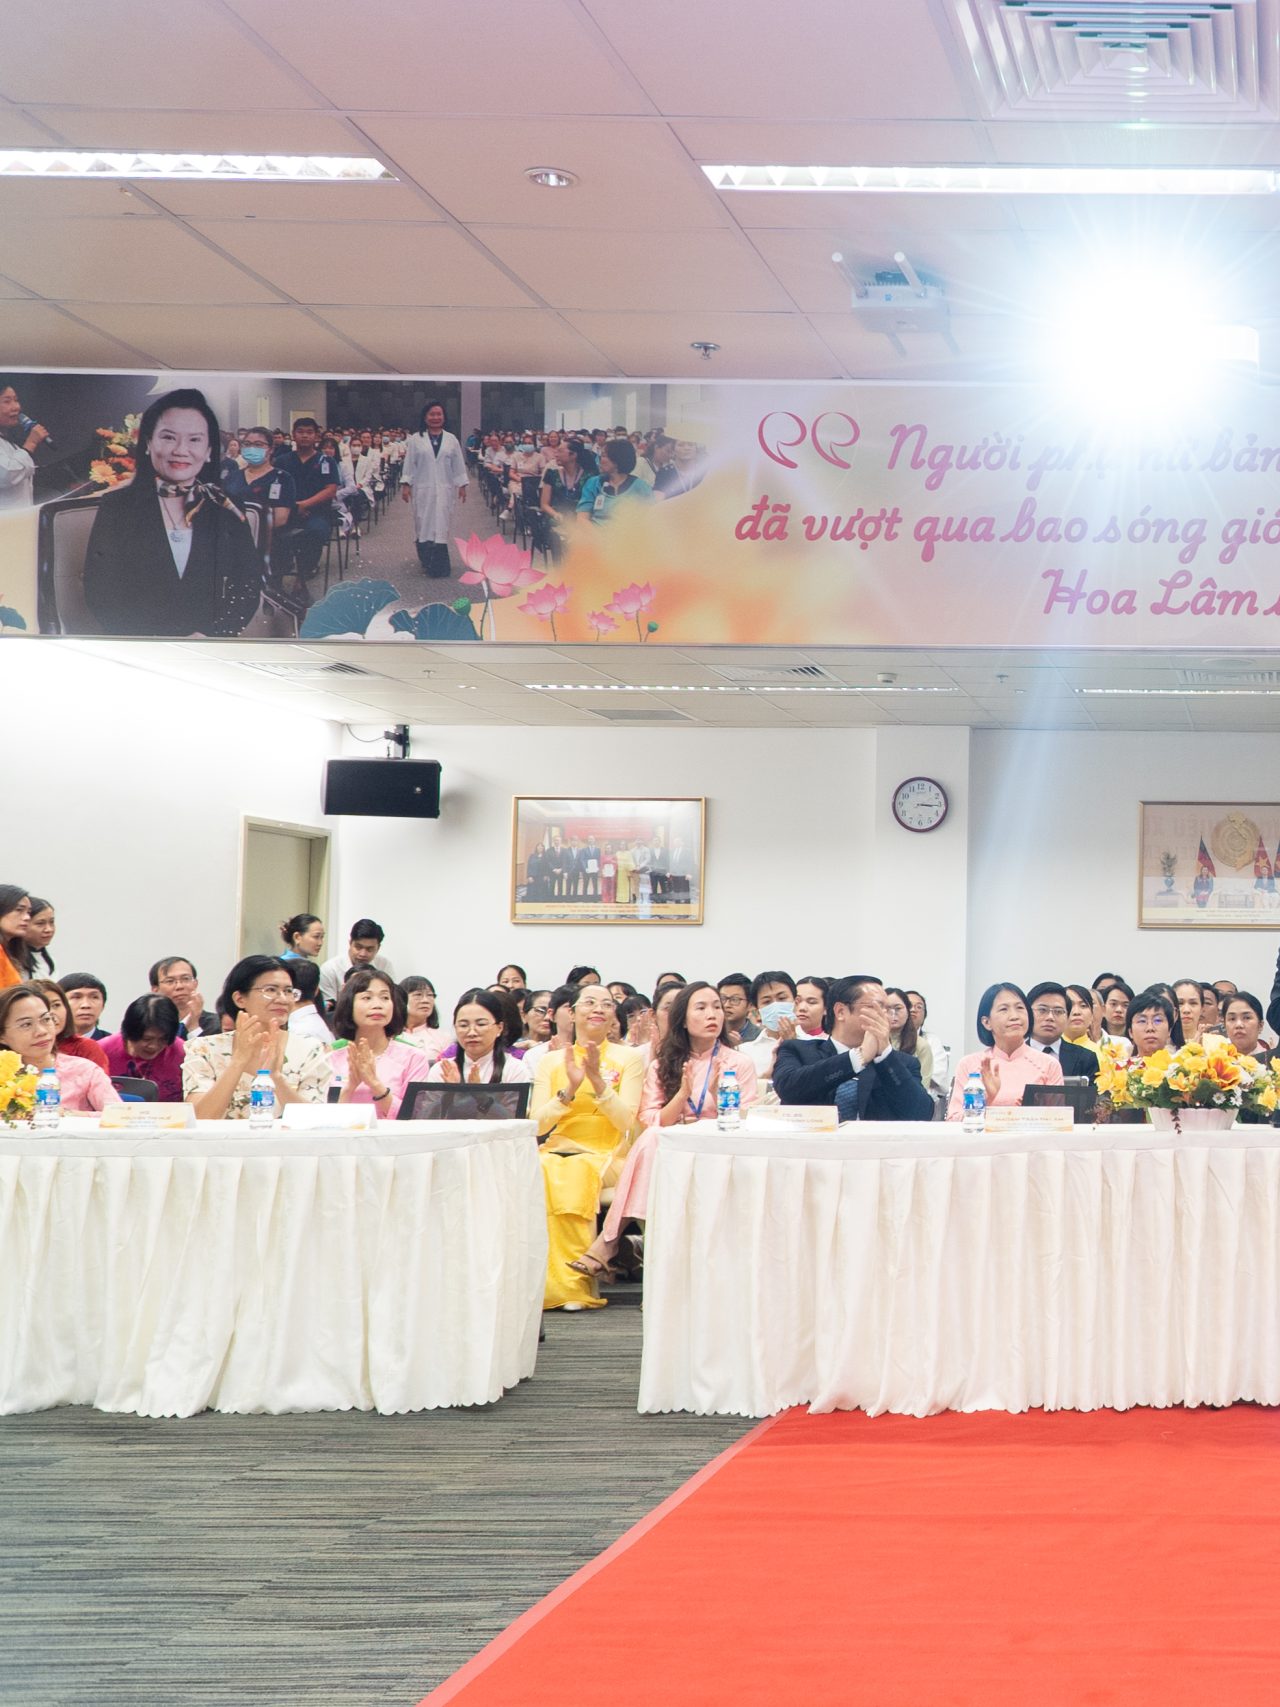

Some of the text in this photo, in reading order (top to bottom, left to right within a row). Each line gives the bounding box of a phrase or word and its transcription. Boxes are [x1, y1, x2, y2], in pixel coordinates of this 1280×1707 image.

[887, 423, 1021, 491] Người
[735, 495, 791, 542] đã
[801, 507, 903, 550] vượt
[913, 514, 995, 562] qua
[1000, 497, 1088, 544] bao
[1092, 505, 1207, 564] sóng
[1041, 568, 1137, 616] Hoa
[1150, 568, 1259, 616] Lâm
